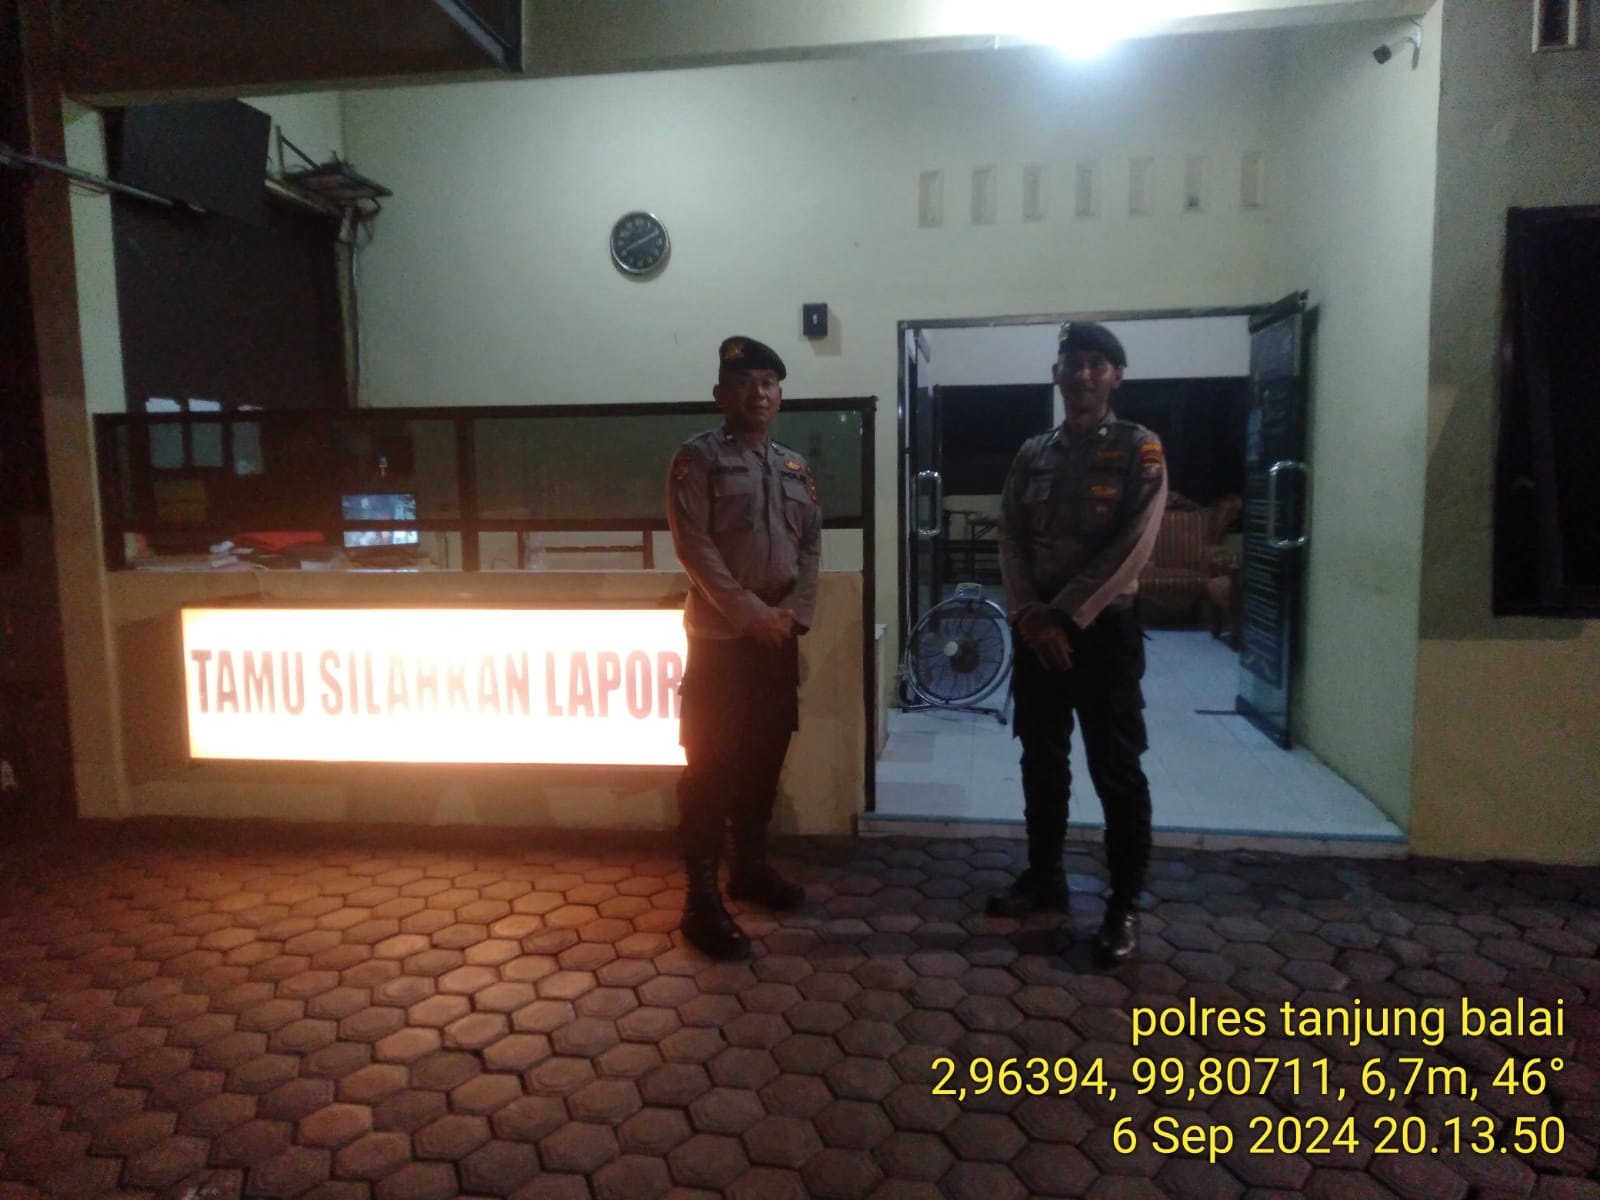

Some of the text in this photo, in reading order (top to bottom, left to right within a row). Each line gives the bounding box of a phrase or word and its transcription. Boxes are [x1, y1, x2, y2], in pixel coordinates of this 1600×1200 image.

[191, 649, 683, 719] TAMU SILAHKAN LAPOR
